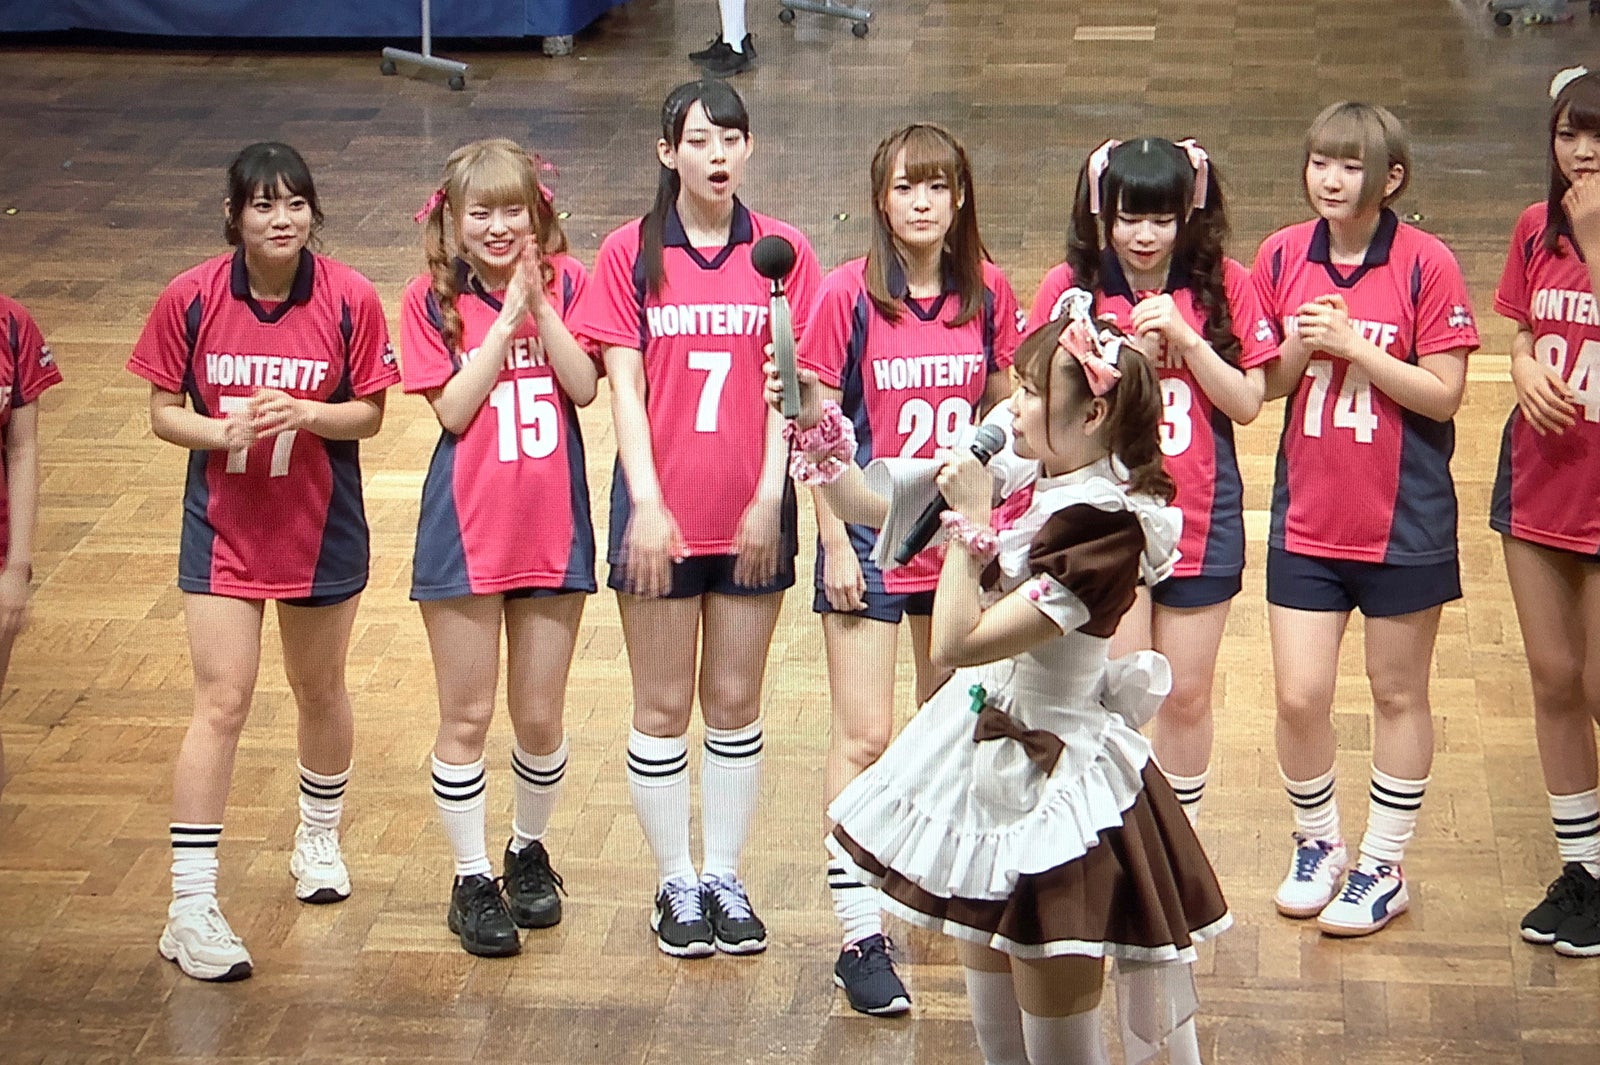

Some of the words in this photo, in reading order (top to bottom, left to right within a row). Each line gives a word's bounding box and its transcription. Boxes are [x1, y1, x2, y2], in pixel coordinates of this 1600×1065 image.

[646, 303, 769, 338] HONTEN7F
[1531, 288, 1600, 326] ONTEN
[205, 353, 329, 391] HONTEN7F
[688, 351, 732, 432] 7
[489, 376, 559, 462] 15
[897, 397, 973, 458] 29
